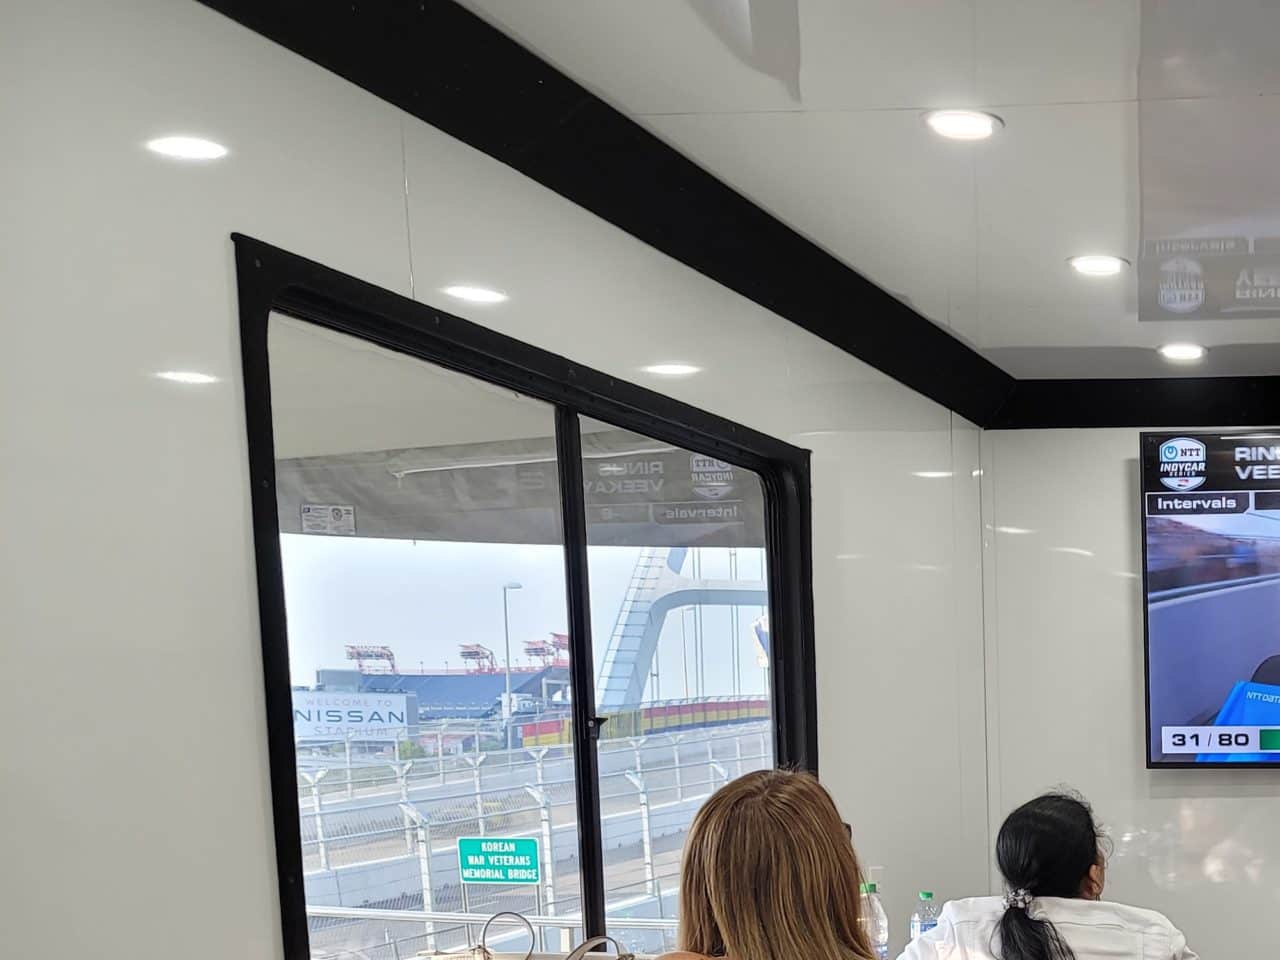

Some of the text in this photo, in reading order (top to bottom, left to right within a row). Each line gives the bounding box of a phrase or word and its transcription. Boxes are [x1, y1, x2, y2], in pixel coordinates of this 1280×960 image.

[1181, 449, 1201, 458] NTT
[1160, 462, 1206, 472] INDYCAR
[1157, 496, 1237, 510] Intervals
[1246, 691, 1262, 701] NTT
[305, 699, 392, 707] WELCOME TO
[294, 710, 404, 723] NISSAN
[313, 726, 388, 737] STADIUM
[1171, 733, 1200, 746] 31
[1218, 733, 1250, 746] 80
[481, 842, 516, 852] KOREAN
[467, 855, 531, 866] WAR VETERANS
[463, 868, 538, 880] MEMORIAL BRIDGE
